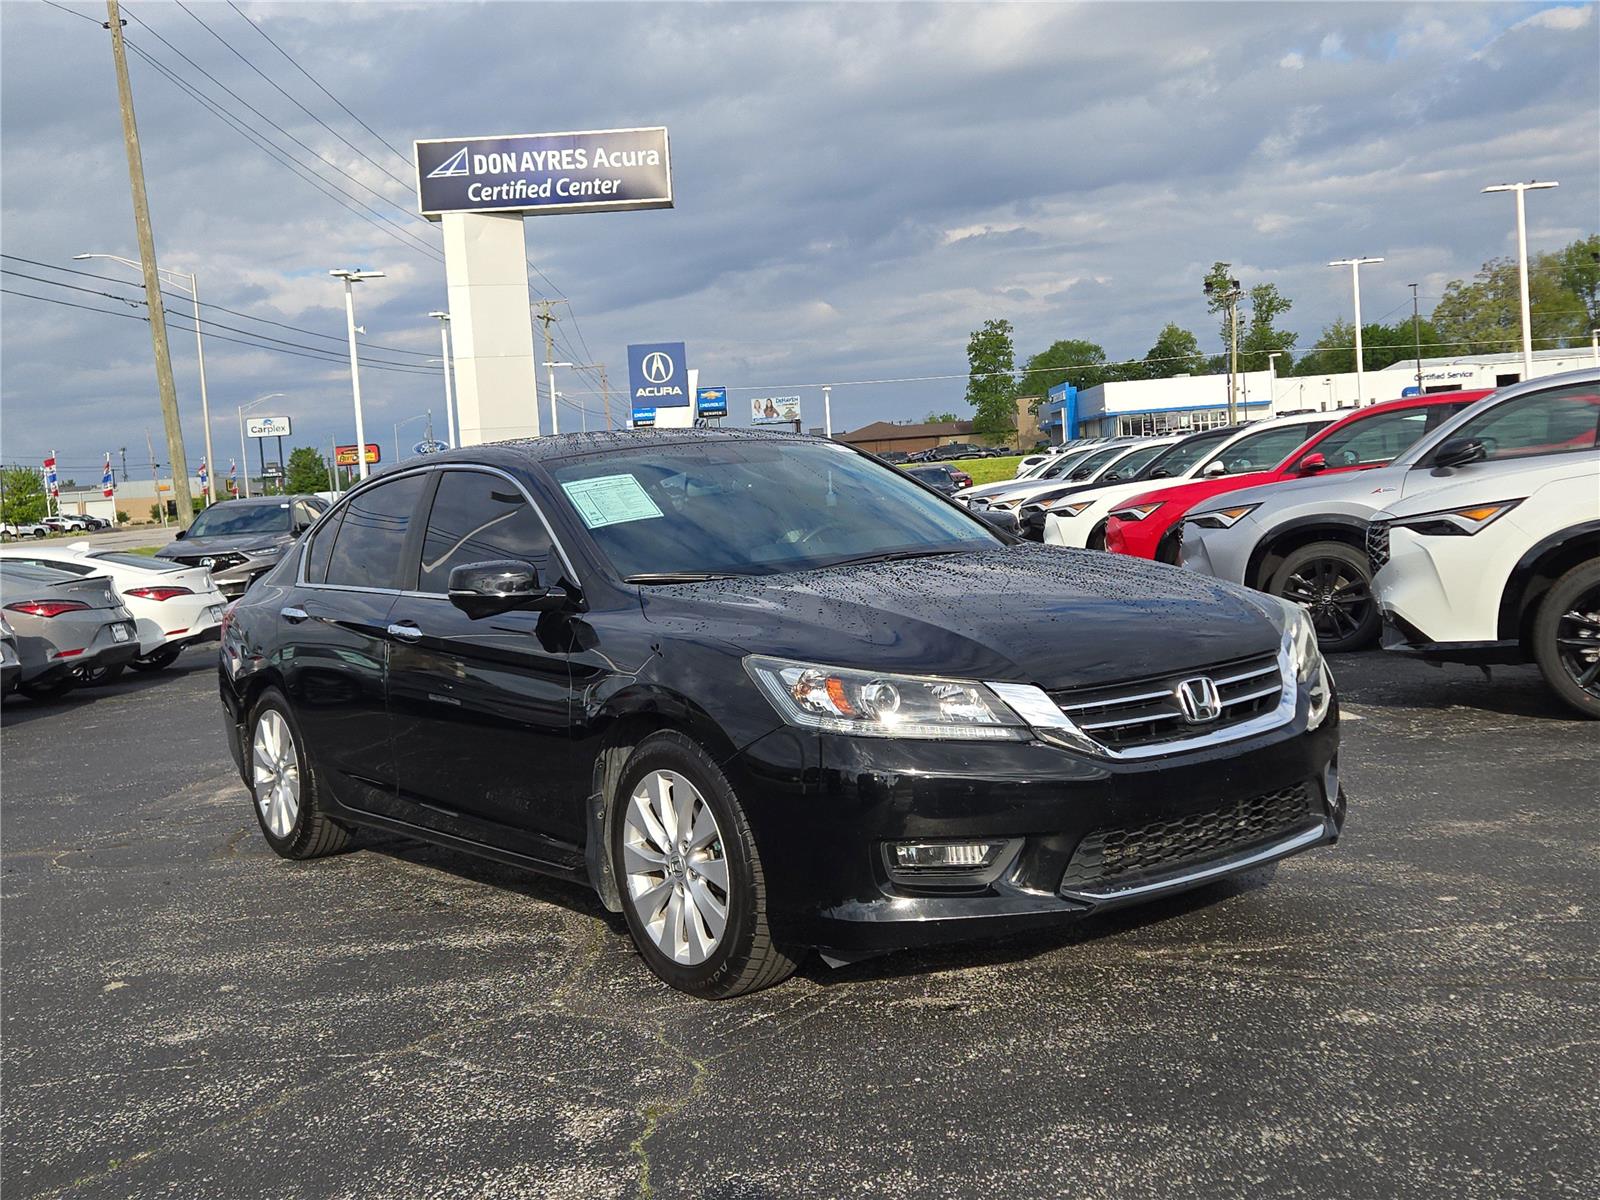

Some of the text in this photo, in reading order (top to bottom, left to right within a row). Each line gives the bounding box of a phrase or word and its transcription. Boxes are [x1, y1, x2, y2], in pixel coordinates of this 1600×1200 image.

[474, 147, 660, 175] DON AYRES Acura
[467, 177, 622, 202] Certified Center
[1447, 371, 1474, 379] Service
[636, 387, 683, 397] ACURA
[251, 425, 286, 435] Carplex
